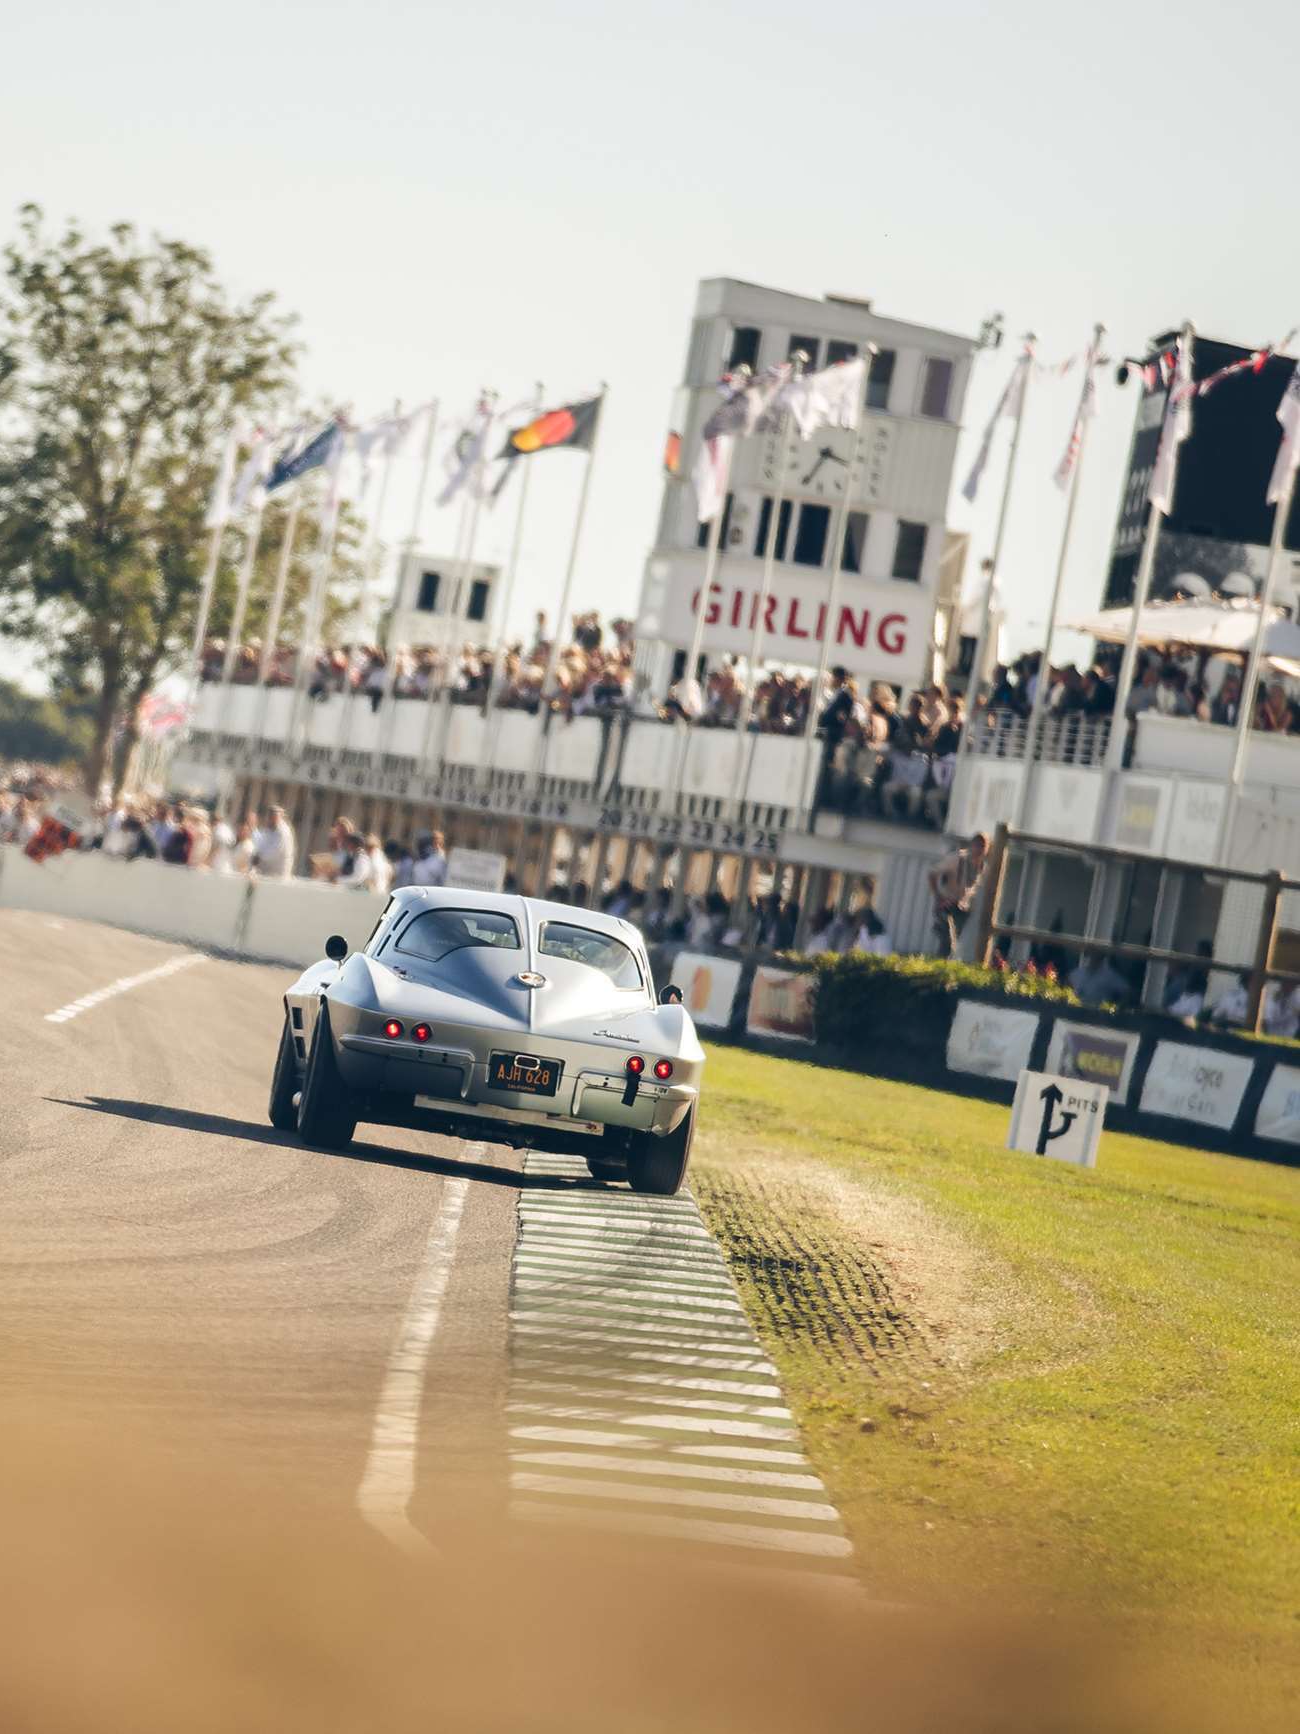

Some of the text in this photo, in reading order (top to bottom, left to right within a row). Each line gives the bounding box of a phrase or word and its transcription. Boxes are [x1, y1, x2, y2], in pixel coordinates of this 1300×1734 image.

[692, 583, 907, 654] GIRLING
[721, 824, 746, 846] 24
[753, 829, 779, 851] 25
[497, 1063, 550, 1086] AJH 628
[1067, 1096, 1100, 1114] PITS
